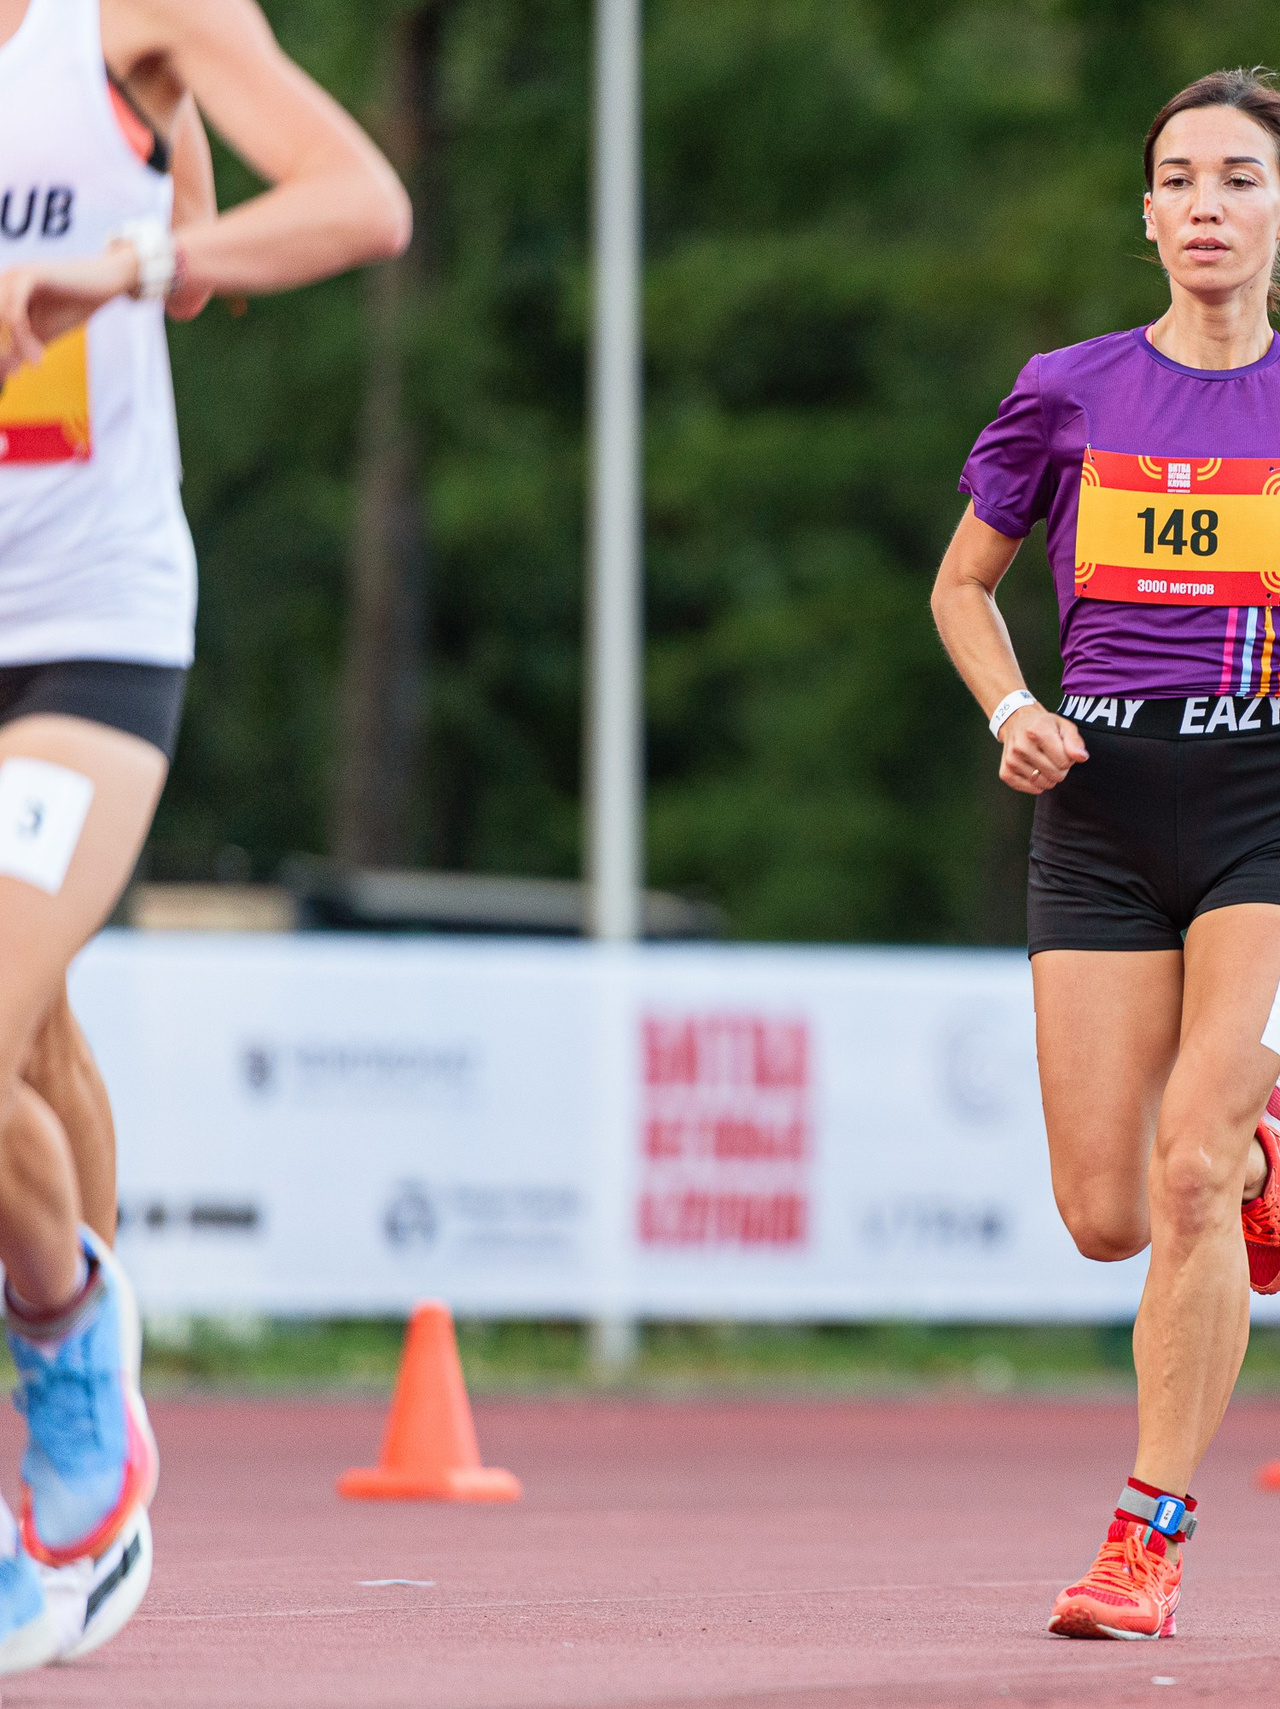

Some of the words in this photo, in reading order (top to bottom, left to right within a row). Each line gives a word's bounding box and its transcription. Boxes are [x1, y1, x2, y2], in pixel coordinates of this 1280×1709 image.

[1136, 507, 1219, 557] 148
[1137, 579, 1167, 593] 3000
[1169, 582, 1215, 597] метров
